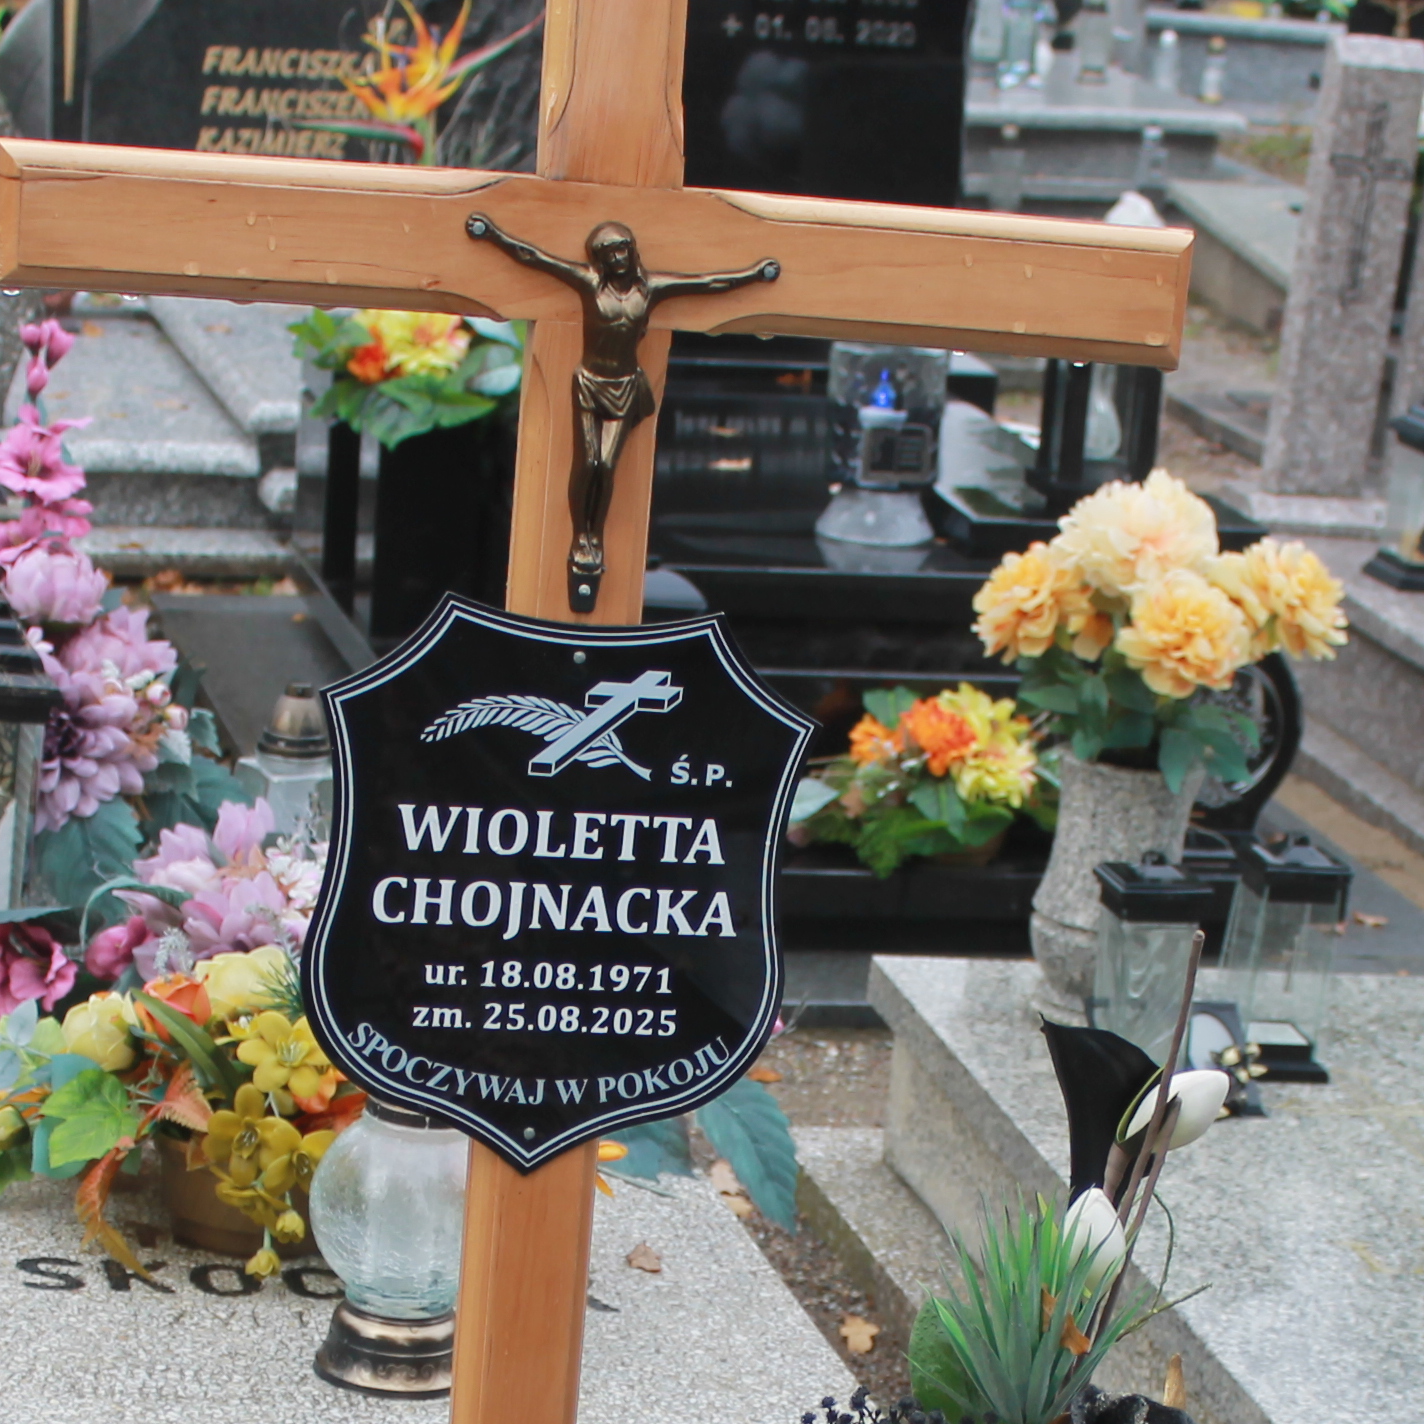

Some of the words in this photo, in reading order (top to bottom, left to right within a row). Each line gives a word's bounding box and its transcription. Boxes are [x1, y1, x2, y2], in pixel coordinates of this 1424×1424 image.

[397, 803, 725, 865] WIOLETTA
[372, 876, 736, 940] CHOJNACKA
[424, 963, 467, 987] ur.
[479, 960, 672, 994] 18.08.1971
[412, 1005, 471, 1029] zm.
[482, 1002, 677, 1037] 25.08.2025
[347, 1022, 545, 1105] SPOCZYWAJ
[555, 1079, 588, 1104] W
[598, 1036, 730, 1104] POKOJU
